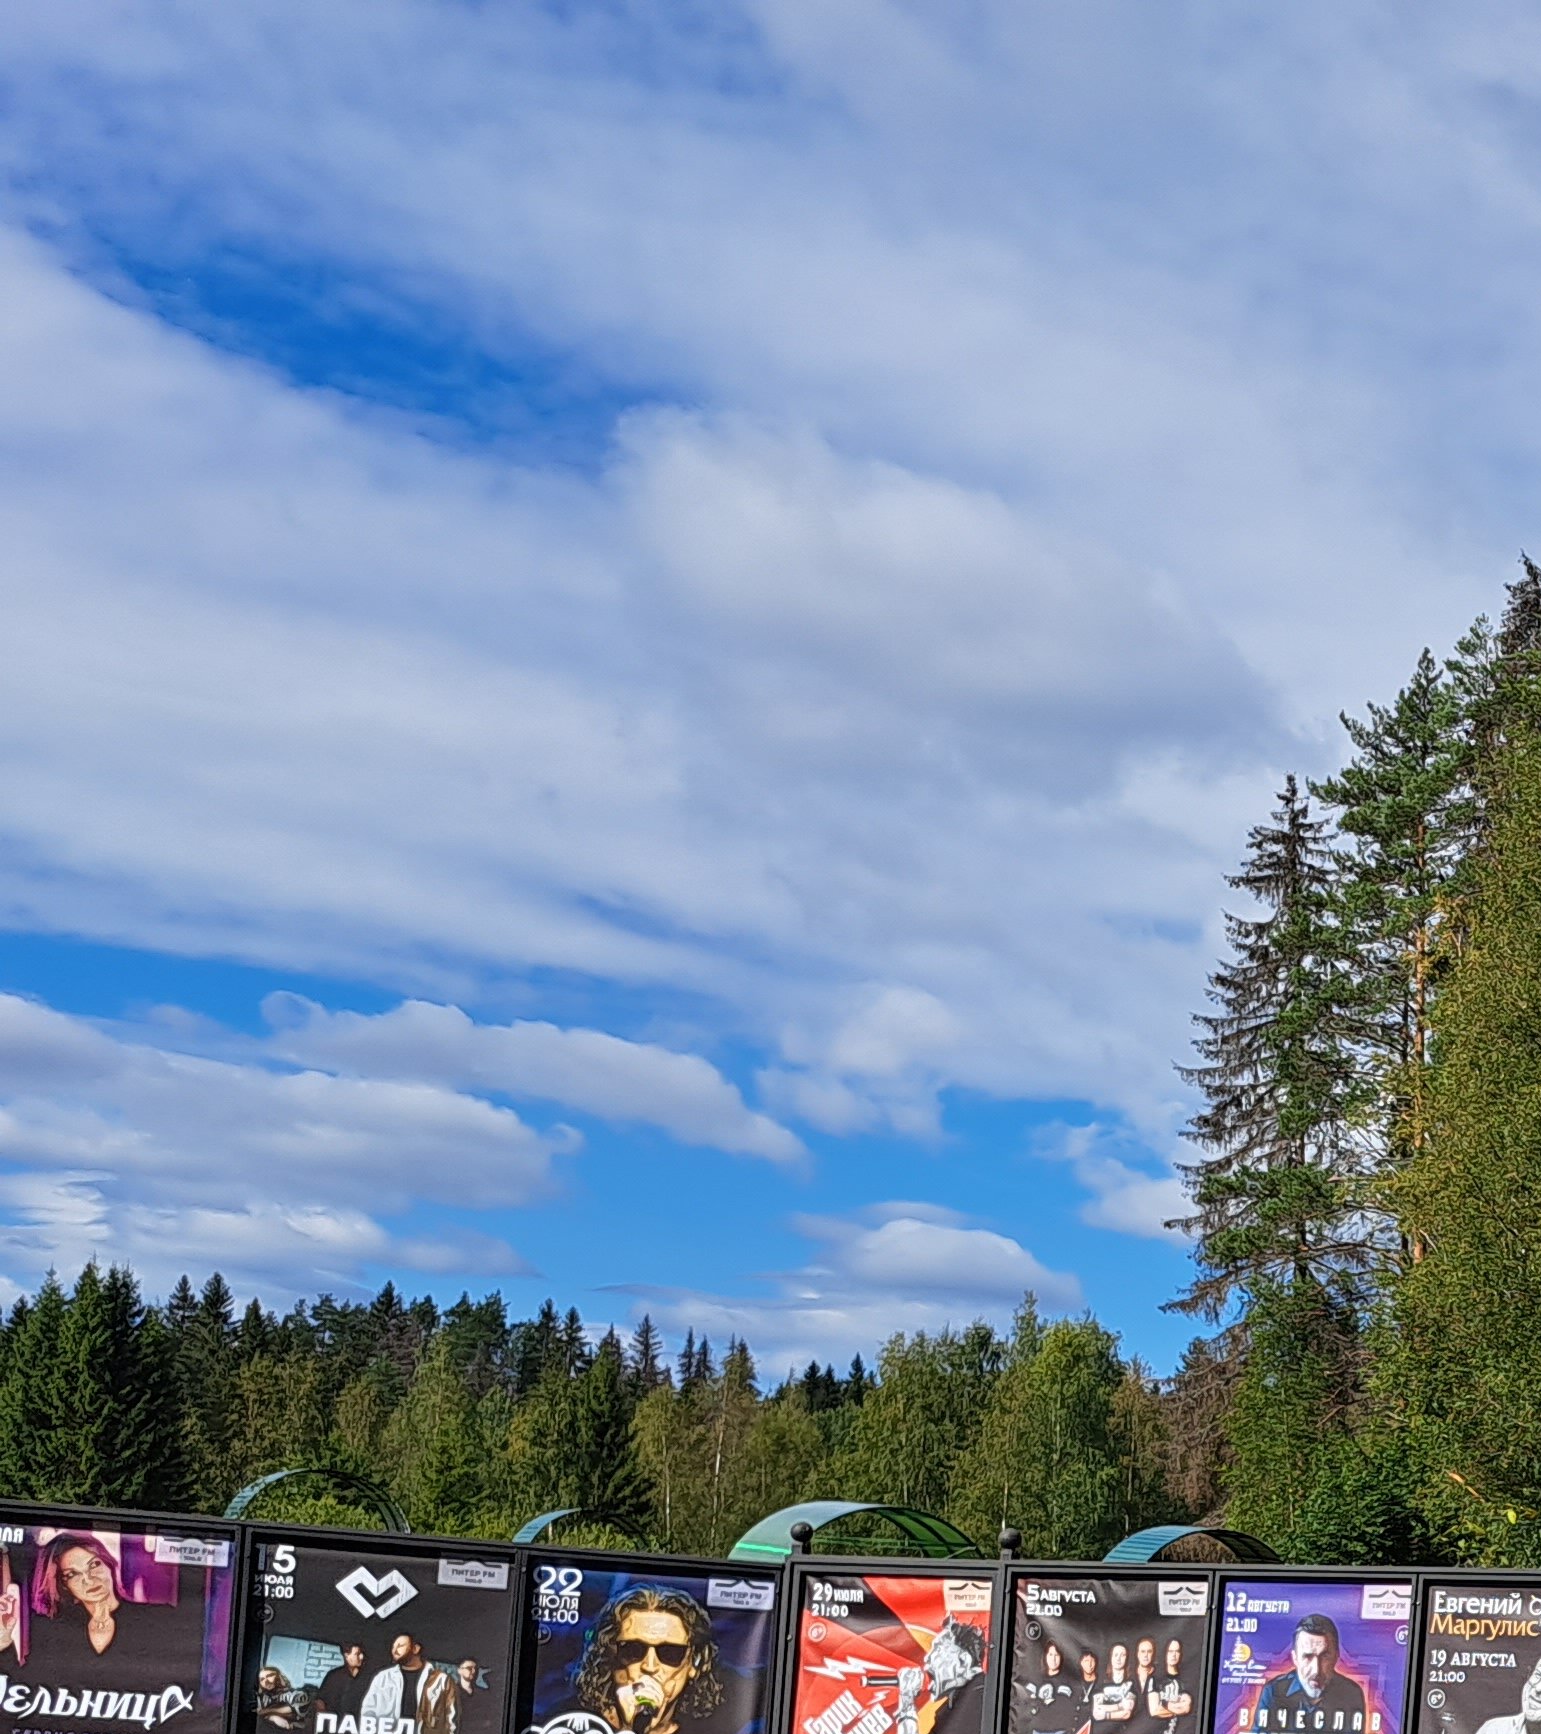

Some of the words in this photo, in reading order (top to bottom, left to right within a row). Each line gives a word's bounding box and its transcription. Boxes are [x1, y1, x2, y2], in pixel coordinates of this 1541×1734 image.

[533, 1565, 583, 1597] 22
[253, 1582, 294, 1600] 21:00
[813, 1582, 832, 1602] 29
[1026, 1584, 1041, 1602] 5
[533, 1594, 580, 1611] ИЮЛЯ
[811, 1603, 849, 1618] 21:00
[1226, 1591, 1247, 1613] 12
[1433, 1590, 1522, 1616] Евгений
[531, 1607, 579, 1625] 21:00
[1226, 1618, 1258, 1633] 21:00
[1429, 1613, 1541, 1641] Маргулис
[1430, 1649, 1447, 1668] 19
[1451, 1651, 1517, 1668] АВГУСТА
[1239, 1707, 1382, 1732] ВЯЧЕСЛАВ
